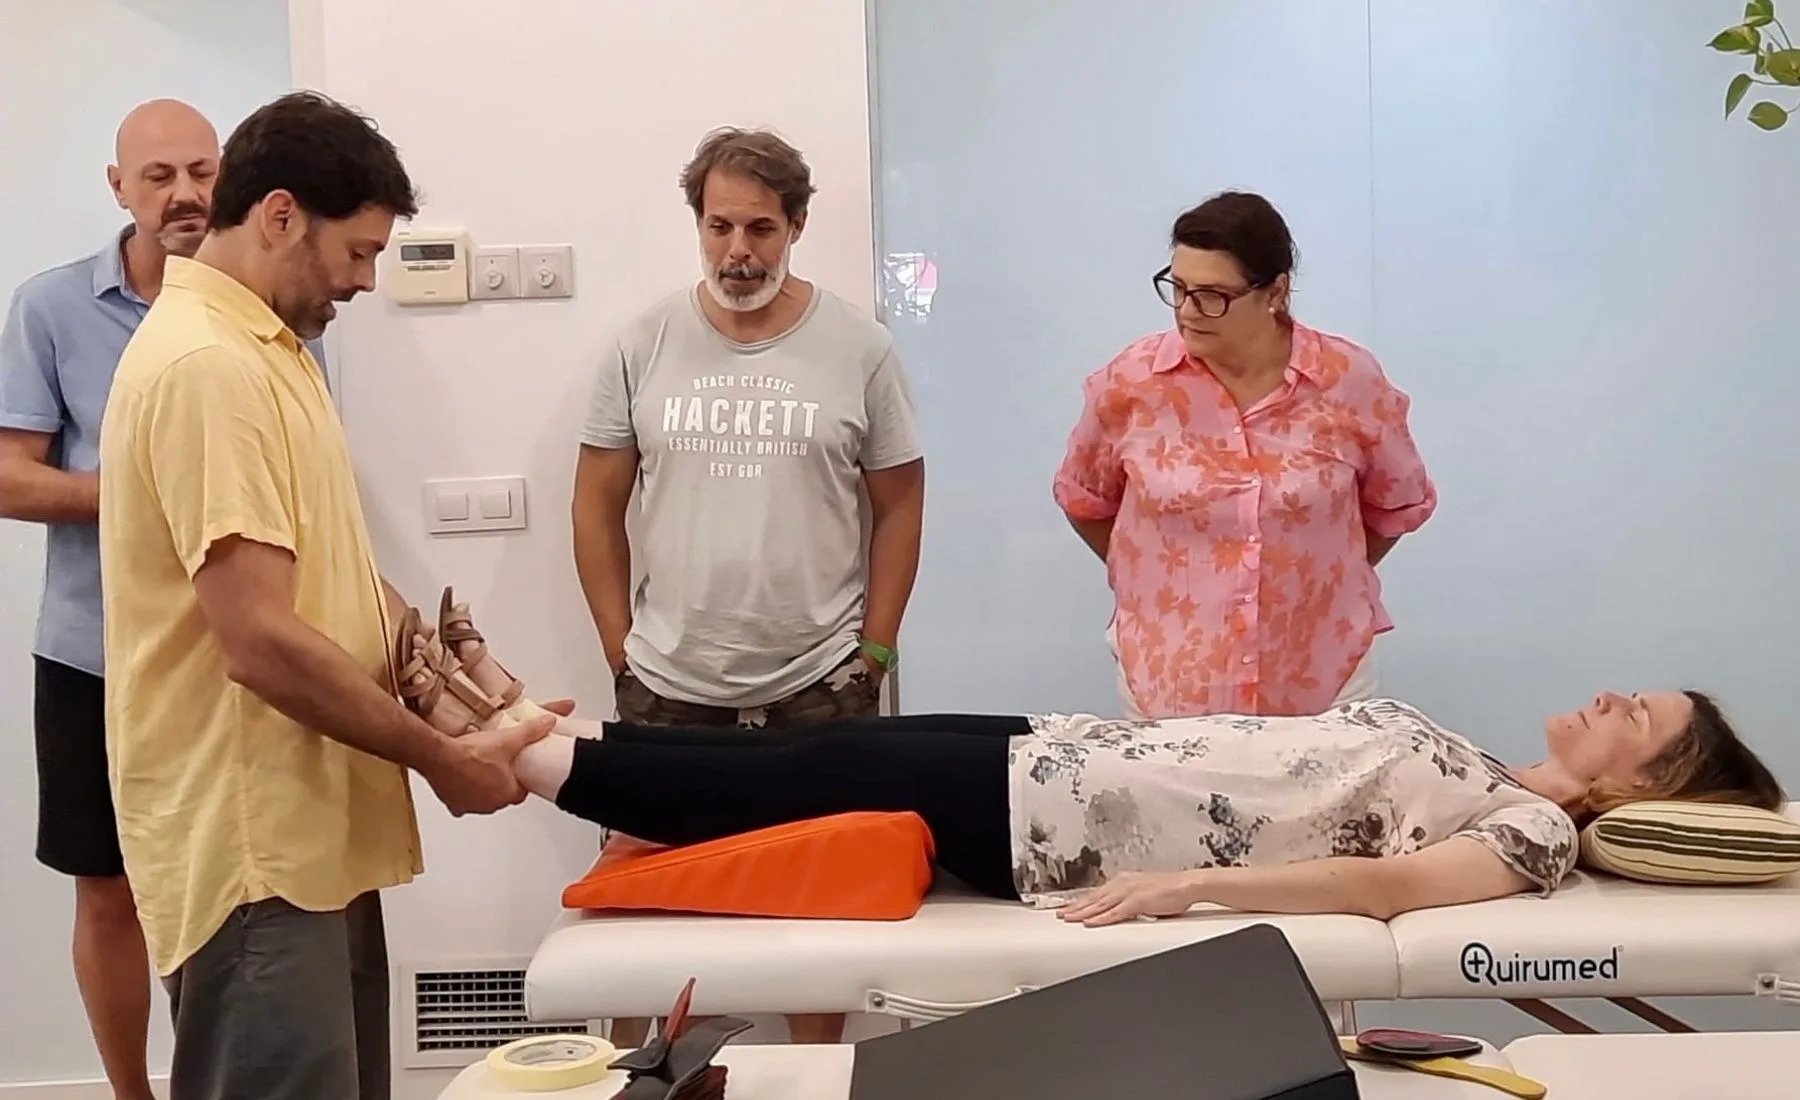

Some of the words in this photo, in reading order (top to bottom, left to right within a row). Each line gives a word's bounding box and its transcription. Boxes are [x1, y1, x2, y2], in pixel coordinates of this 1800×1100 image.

[693, 375, 735, 390] BEACH
[741, 375, 795, 394] CLASSIC
[662, 396, 819, 438] HACKETT
[669, 437, 751, 456] ESSENTIALLY
[756, 441, 808, 456] BRITISH
[710, 462, 733, 477] EST
[1460, 942, 1618, 986] Quirumed
